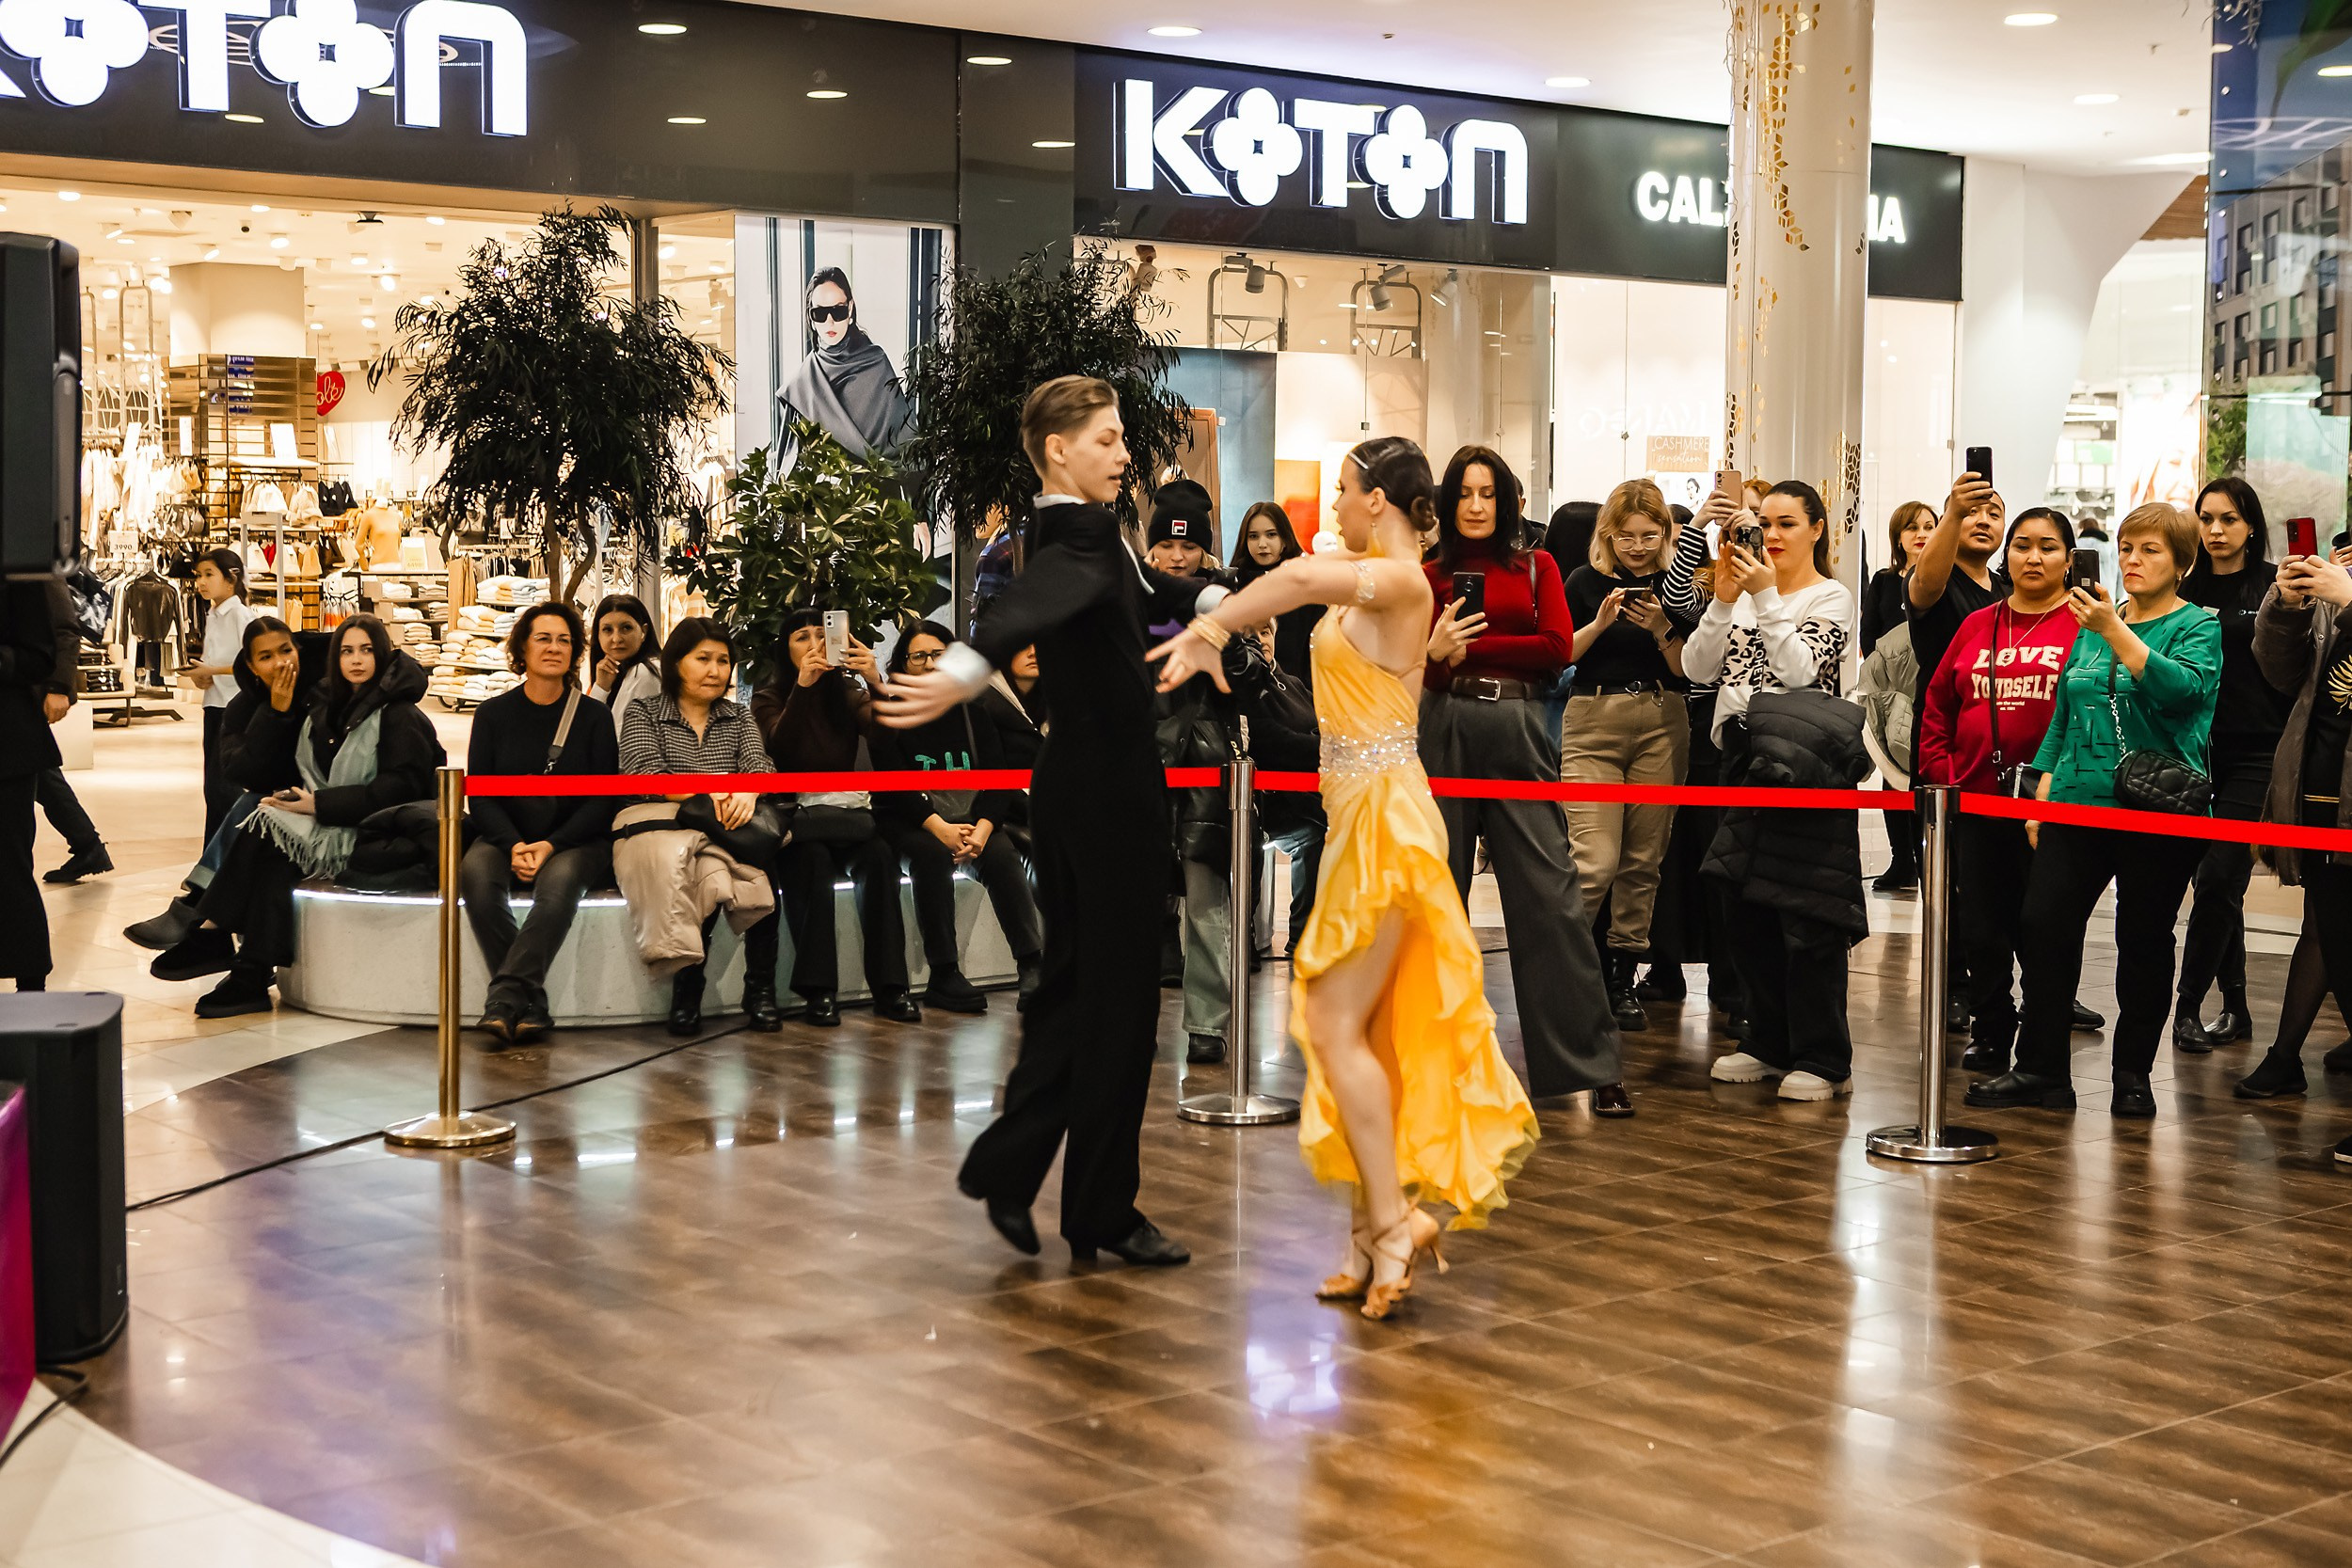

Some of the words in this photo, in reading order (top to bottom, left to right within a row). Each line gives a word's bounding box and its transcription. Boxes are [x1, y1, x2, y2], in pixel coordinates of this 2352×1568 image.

[0, 0, 528, 136] OTON
[1114, 79, 1529, 224] KOTON
[1654, 436, 1709, 451] CASHMERE
[1972, 645, 2064, 671] LOVE
